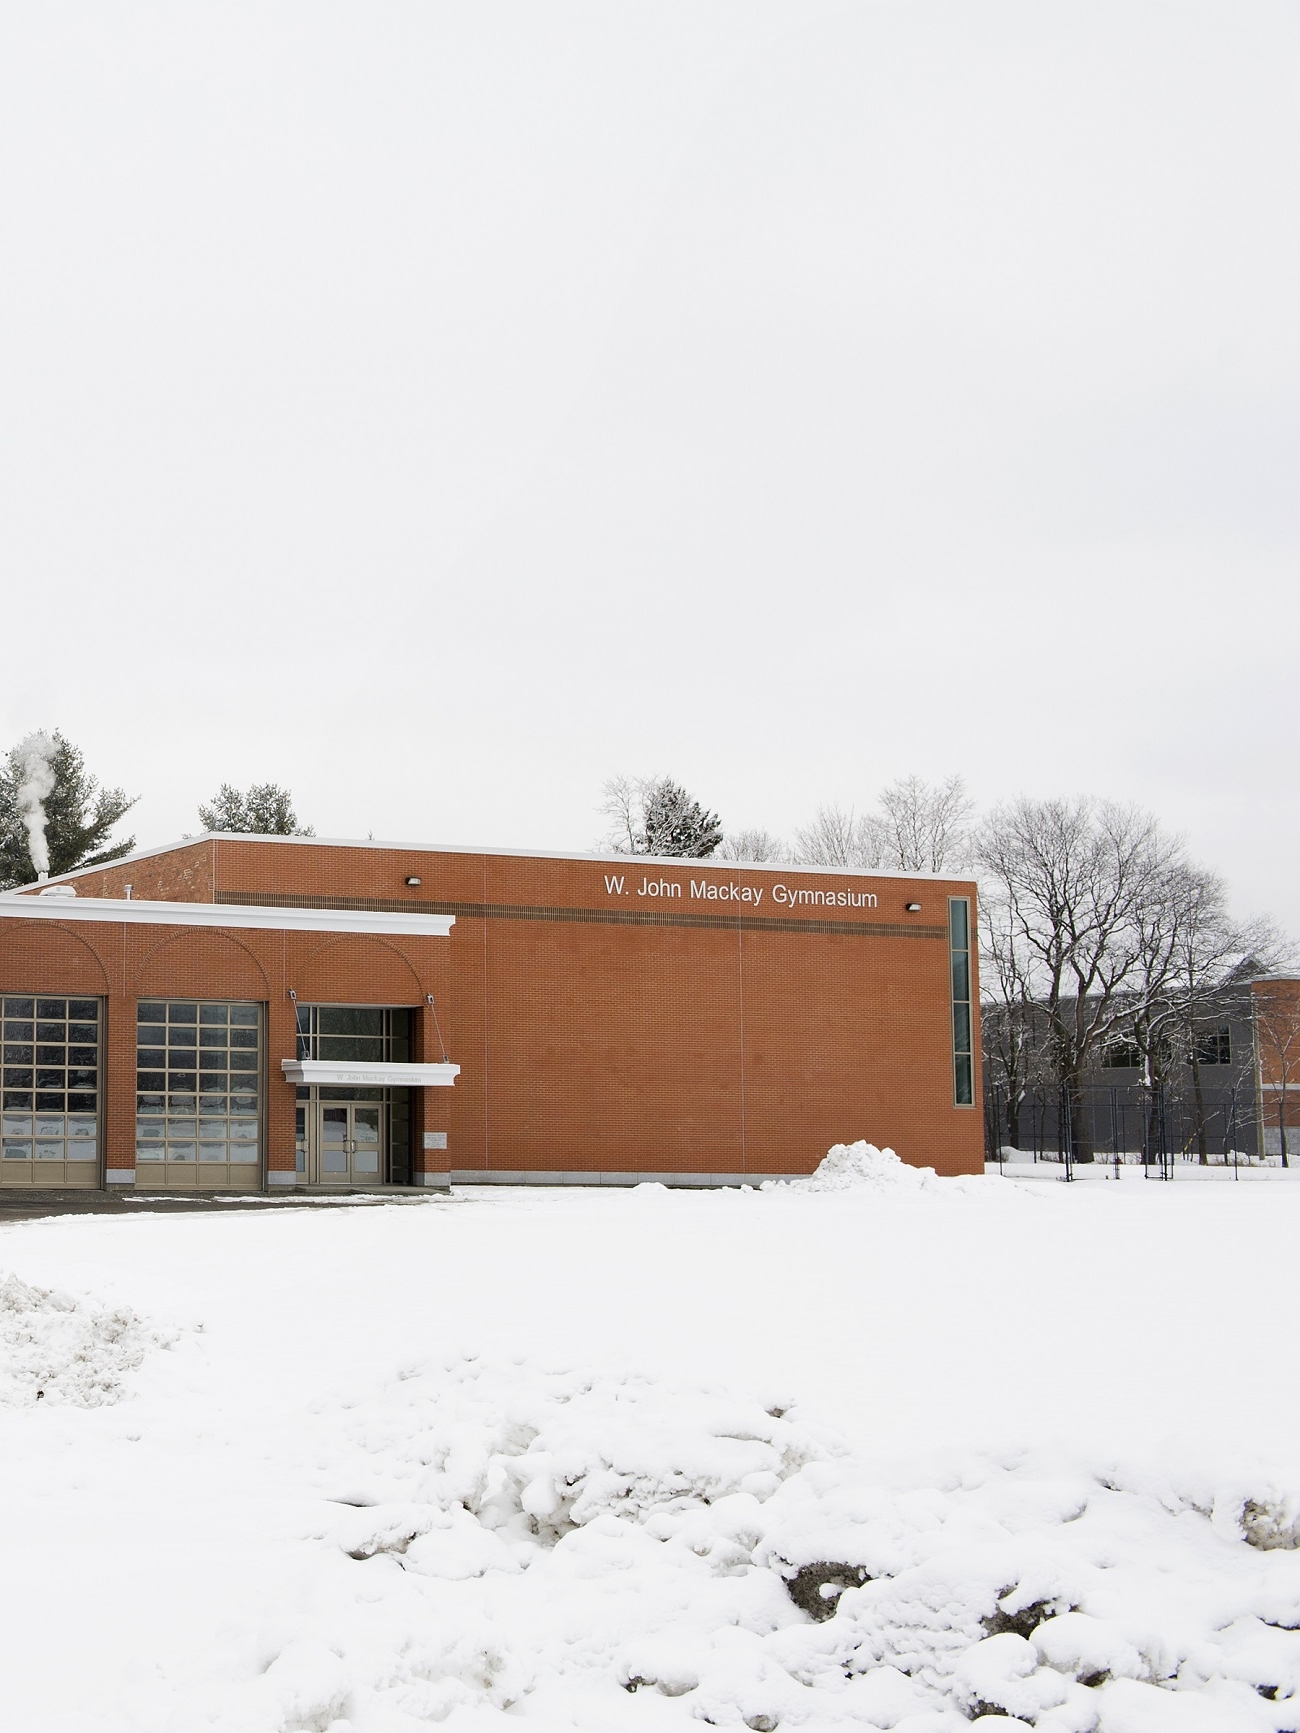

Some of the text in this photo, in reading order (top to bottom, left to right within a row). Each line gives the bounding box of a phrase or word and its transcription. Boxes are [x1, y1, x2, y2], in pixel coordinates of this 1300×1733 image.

[604, 875, 878, 909] W. John Mackay Gymnasium
[347, 1074, 360, 1082] John
[362, 1075, 385, 1083] Mackay
[388, 1075, 422, 1083] Gymnasium
